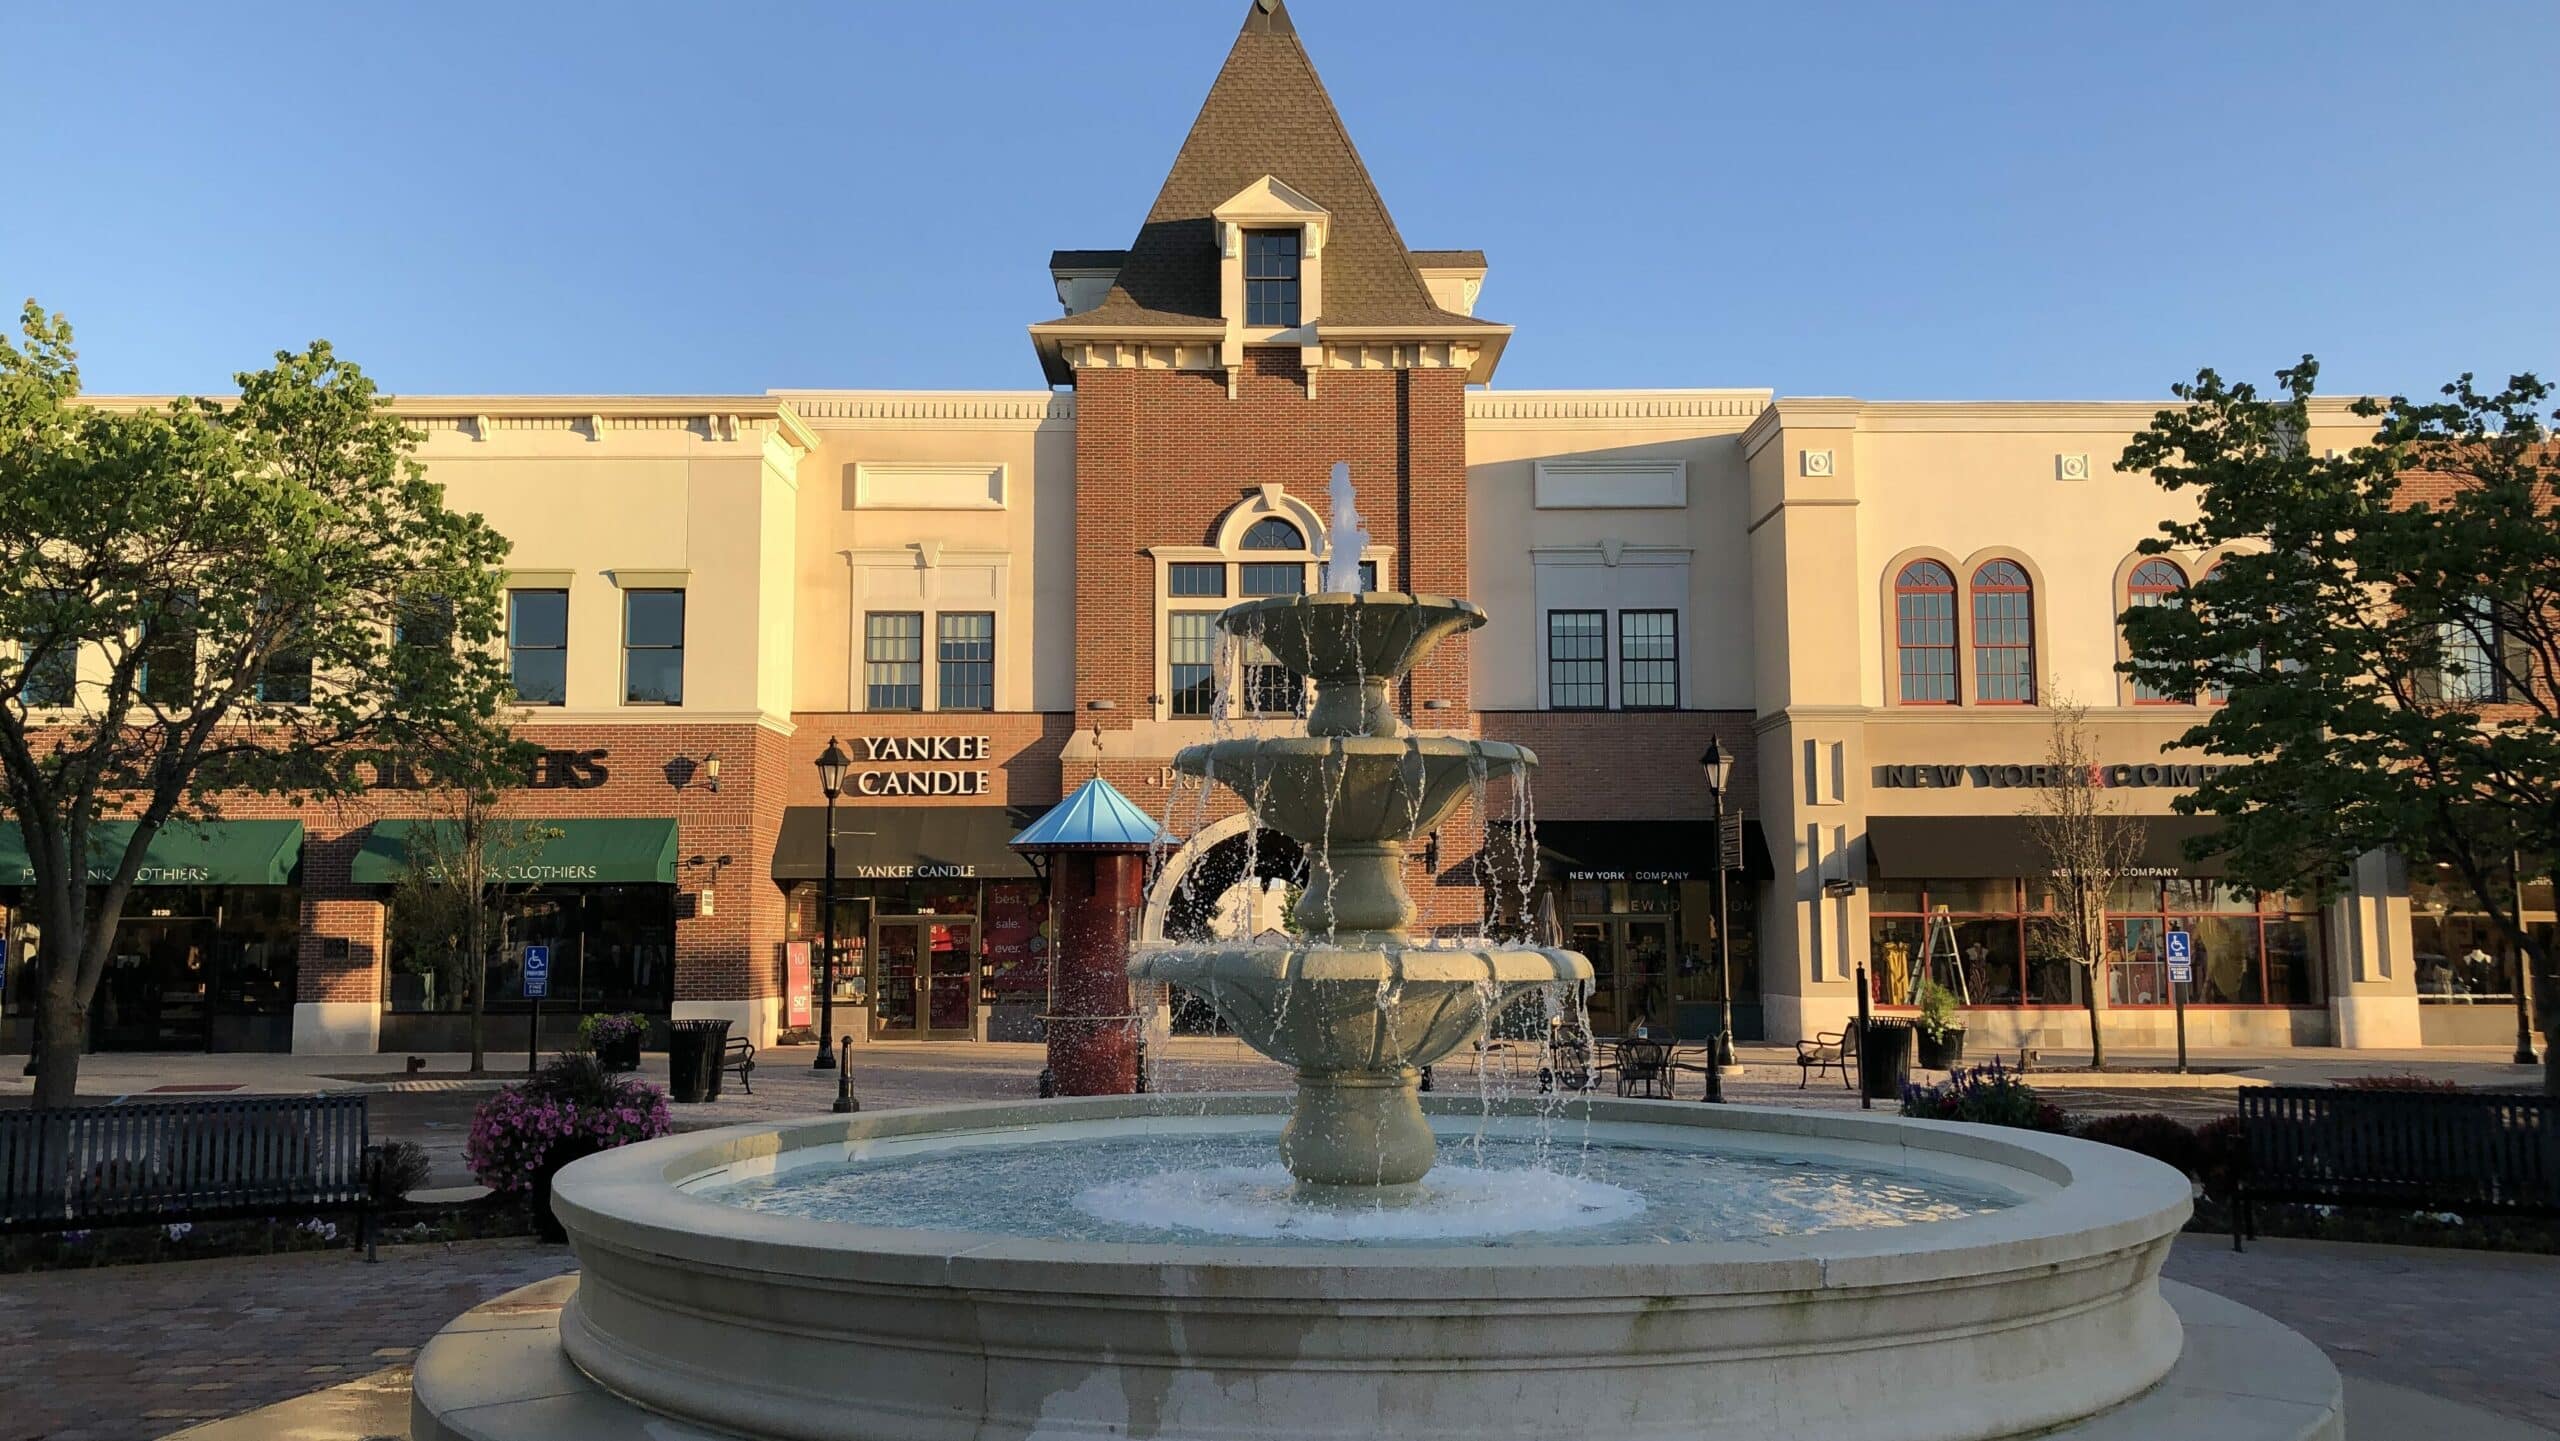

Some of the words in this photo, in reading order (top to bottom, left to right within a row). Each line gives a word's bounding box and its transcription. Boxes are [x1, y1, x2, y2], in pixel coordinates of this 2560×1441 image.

[862, 735, 991, 760] YANKEE
[858, 770, 991, 795] CANDLE
[1886, 764, 1966, 788] NEW
[507, 865, 597, 879] CLOTHIERS
[857, 865, 914, 878] YANKEE
[917, 865, 975, 878] CANDLE
[1569, 871, 1594, 880] NEW
[1596, 871, 1625, 880] YORK
[1635, 871, 1689, 880] COMPANY
[2121, 867, 2179, 877] COMPANY
[996, 917, 1021, 929] sale.
[995, 945, 1021, 953] ever.
